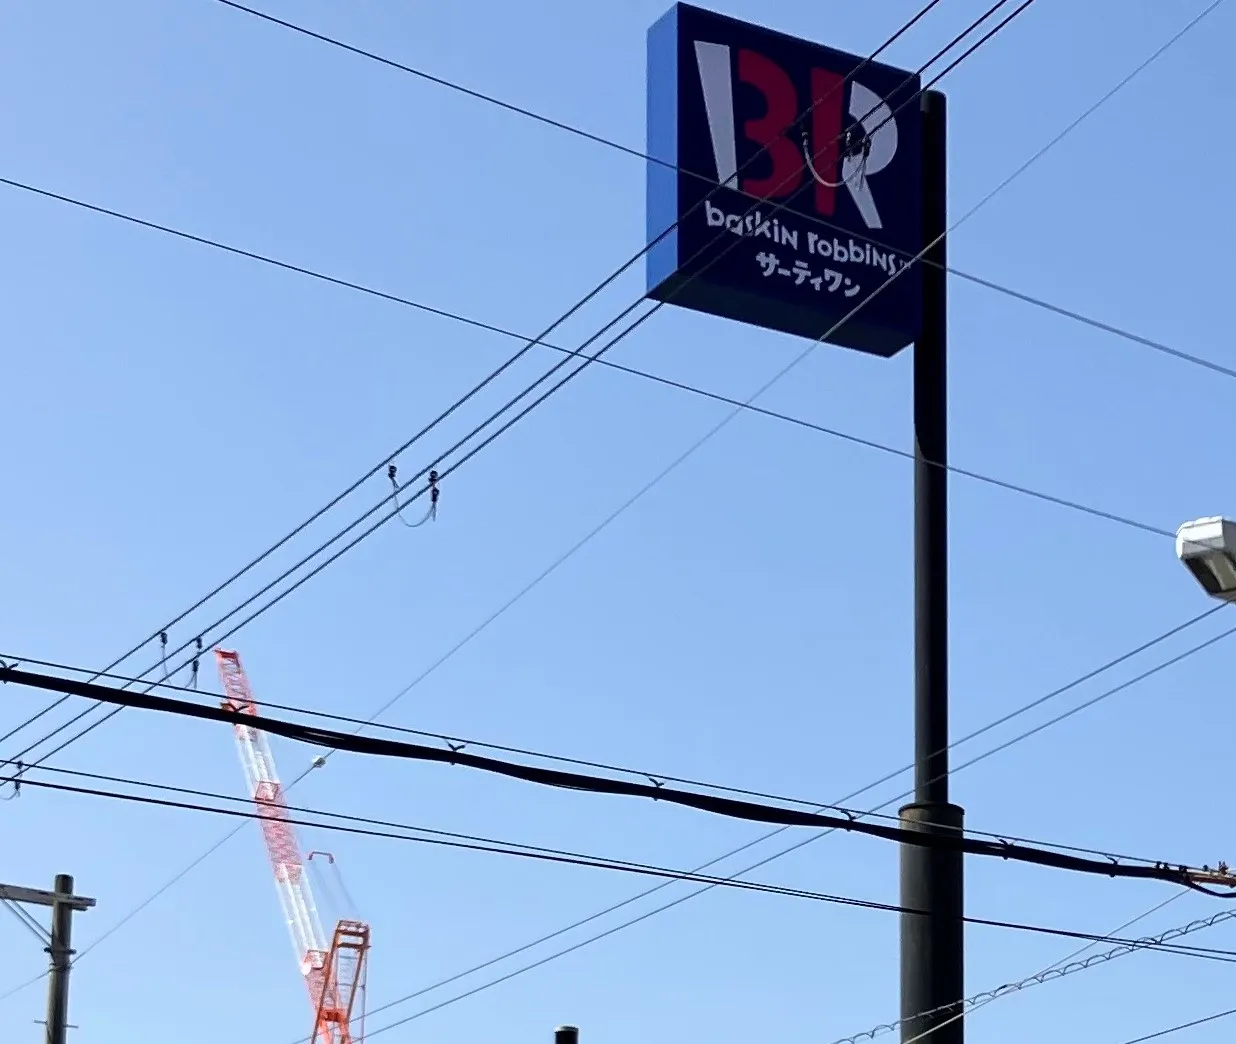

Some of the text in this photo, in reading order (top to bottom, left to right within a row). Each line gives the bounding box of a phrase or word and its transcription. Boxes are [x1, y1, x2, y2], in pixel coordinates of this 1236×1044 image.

[755, 251, 861, 298] サーティワン
